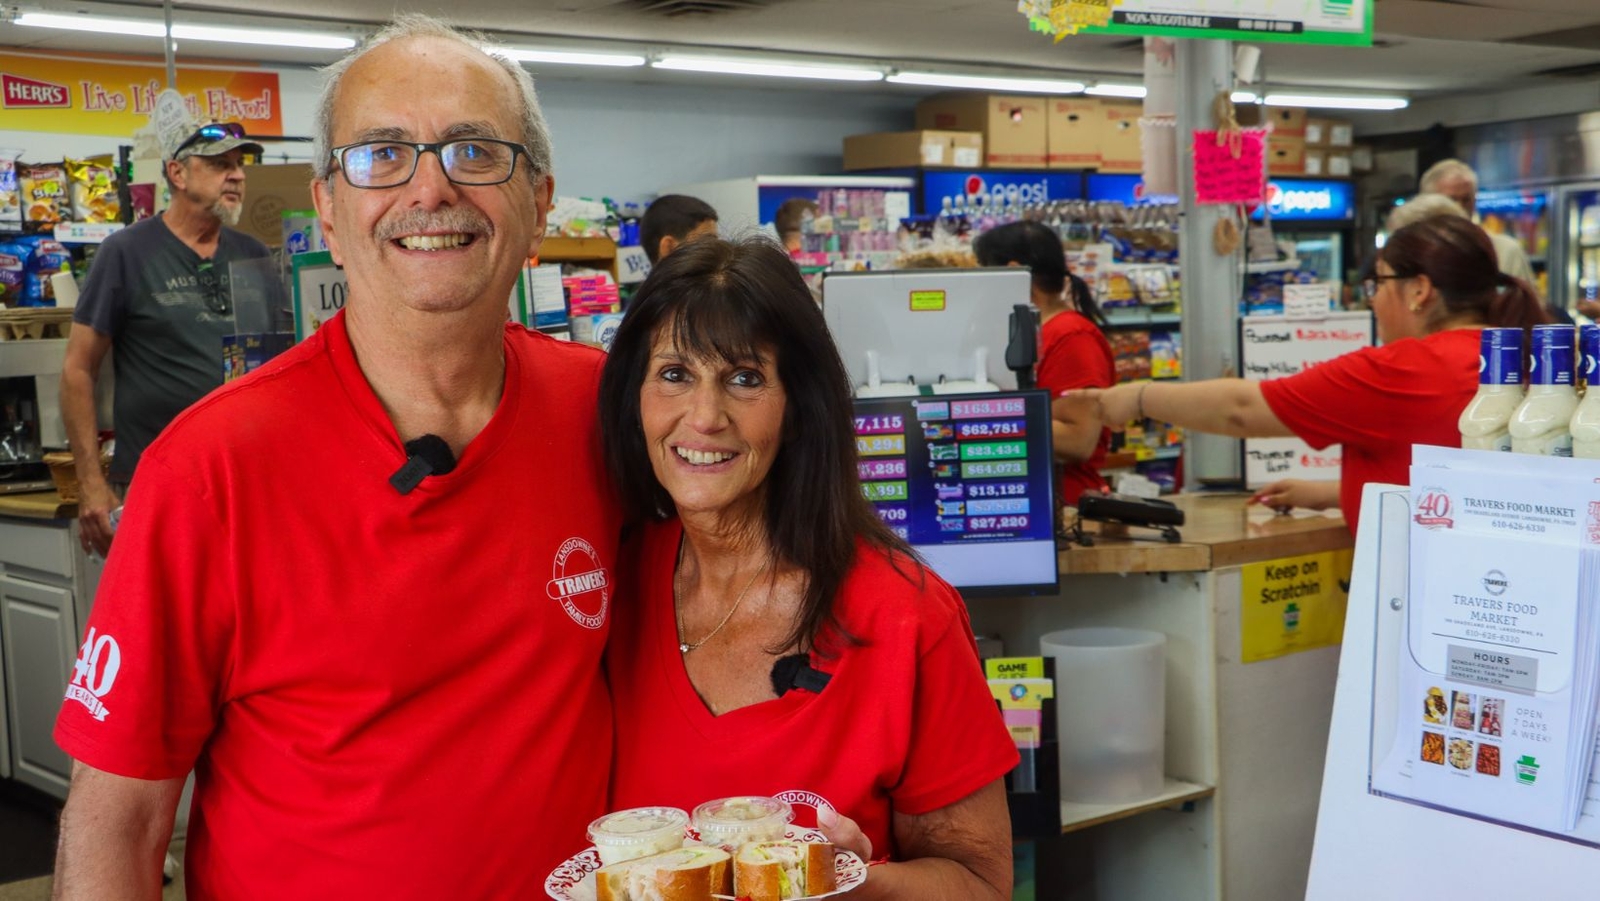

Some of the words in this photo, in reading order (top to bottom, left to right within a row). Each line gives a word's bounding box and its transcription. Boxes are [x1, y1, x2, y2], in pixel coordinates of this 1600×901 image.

[1125, 13, 1210, 27] NON-NEGOTIABLE
[9, 82, 63, 103] HERR'S
[79, 80, 126, 113] Live
[205, 87, 271, 119] Flavor!
[991, 179, 1048, 207] pepsi
[1284, 188, 1330, 213] pepsi
[953, 402, 1023, 415] $163,168
[855, 416, 903, 431] 7,115
[962, 423, 1019, 436] $62,781
[967, 445, 1020, 456] $23,434
[968, 464, 1021, 475] $64,073
[969, 484, 1025, 497] $13,122
[1419, 493, 1449, 517] 40
[1464, 498, 1505, 511] TRAVERS
[1507, 502, 1532, 514] FOOD
[1535, 505, 1576, 518] MARKET
[970, 516, 1028, 530] $27,220
[556, 540, 596, 566] LANSDOWNE'S
[1265, 564, 1298, 581] Keep
[1302, 562, 1318, 575] on
[556, 570, 606, 596] TRAVERS
[1484, 578, 1508, 587] TRAVERS
[1453, 595, 1503, 611] TRAVERS
[1506, 602, 1538, 615] FOOD
[565, 600, 586, 625] FAMILY
[586, 616, 603, 628] FOOD
[1470, 611, 1518, 626] MARKET
[73, 627, 121, 697] 40
[1474, 653, 1510, 665] HOURS
[997, 663, 1027, 672] GAME
[1516, 708, 1543, 719] OPEN
[1522, 719, 1547, 732] DAYS
